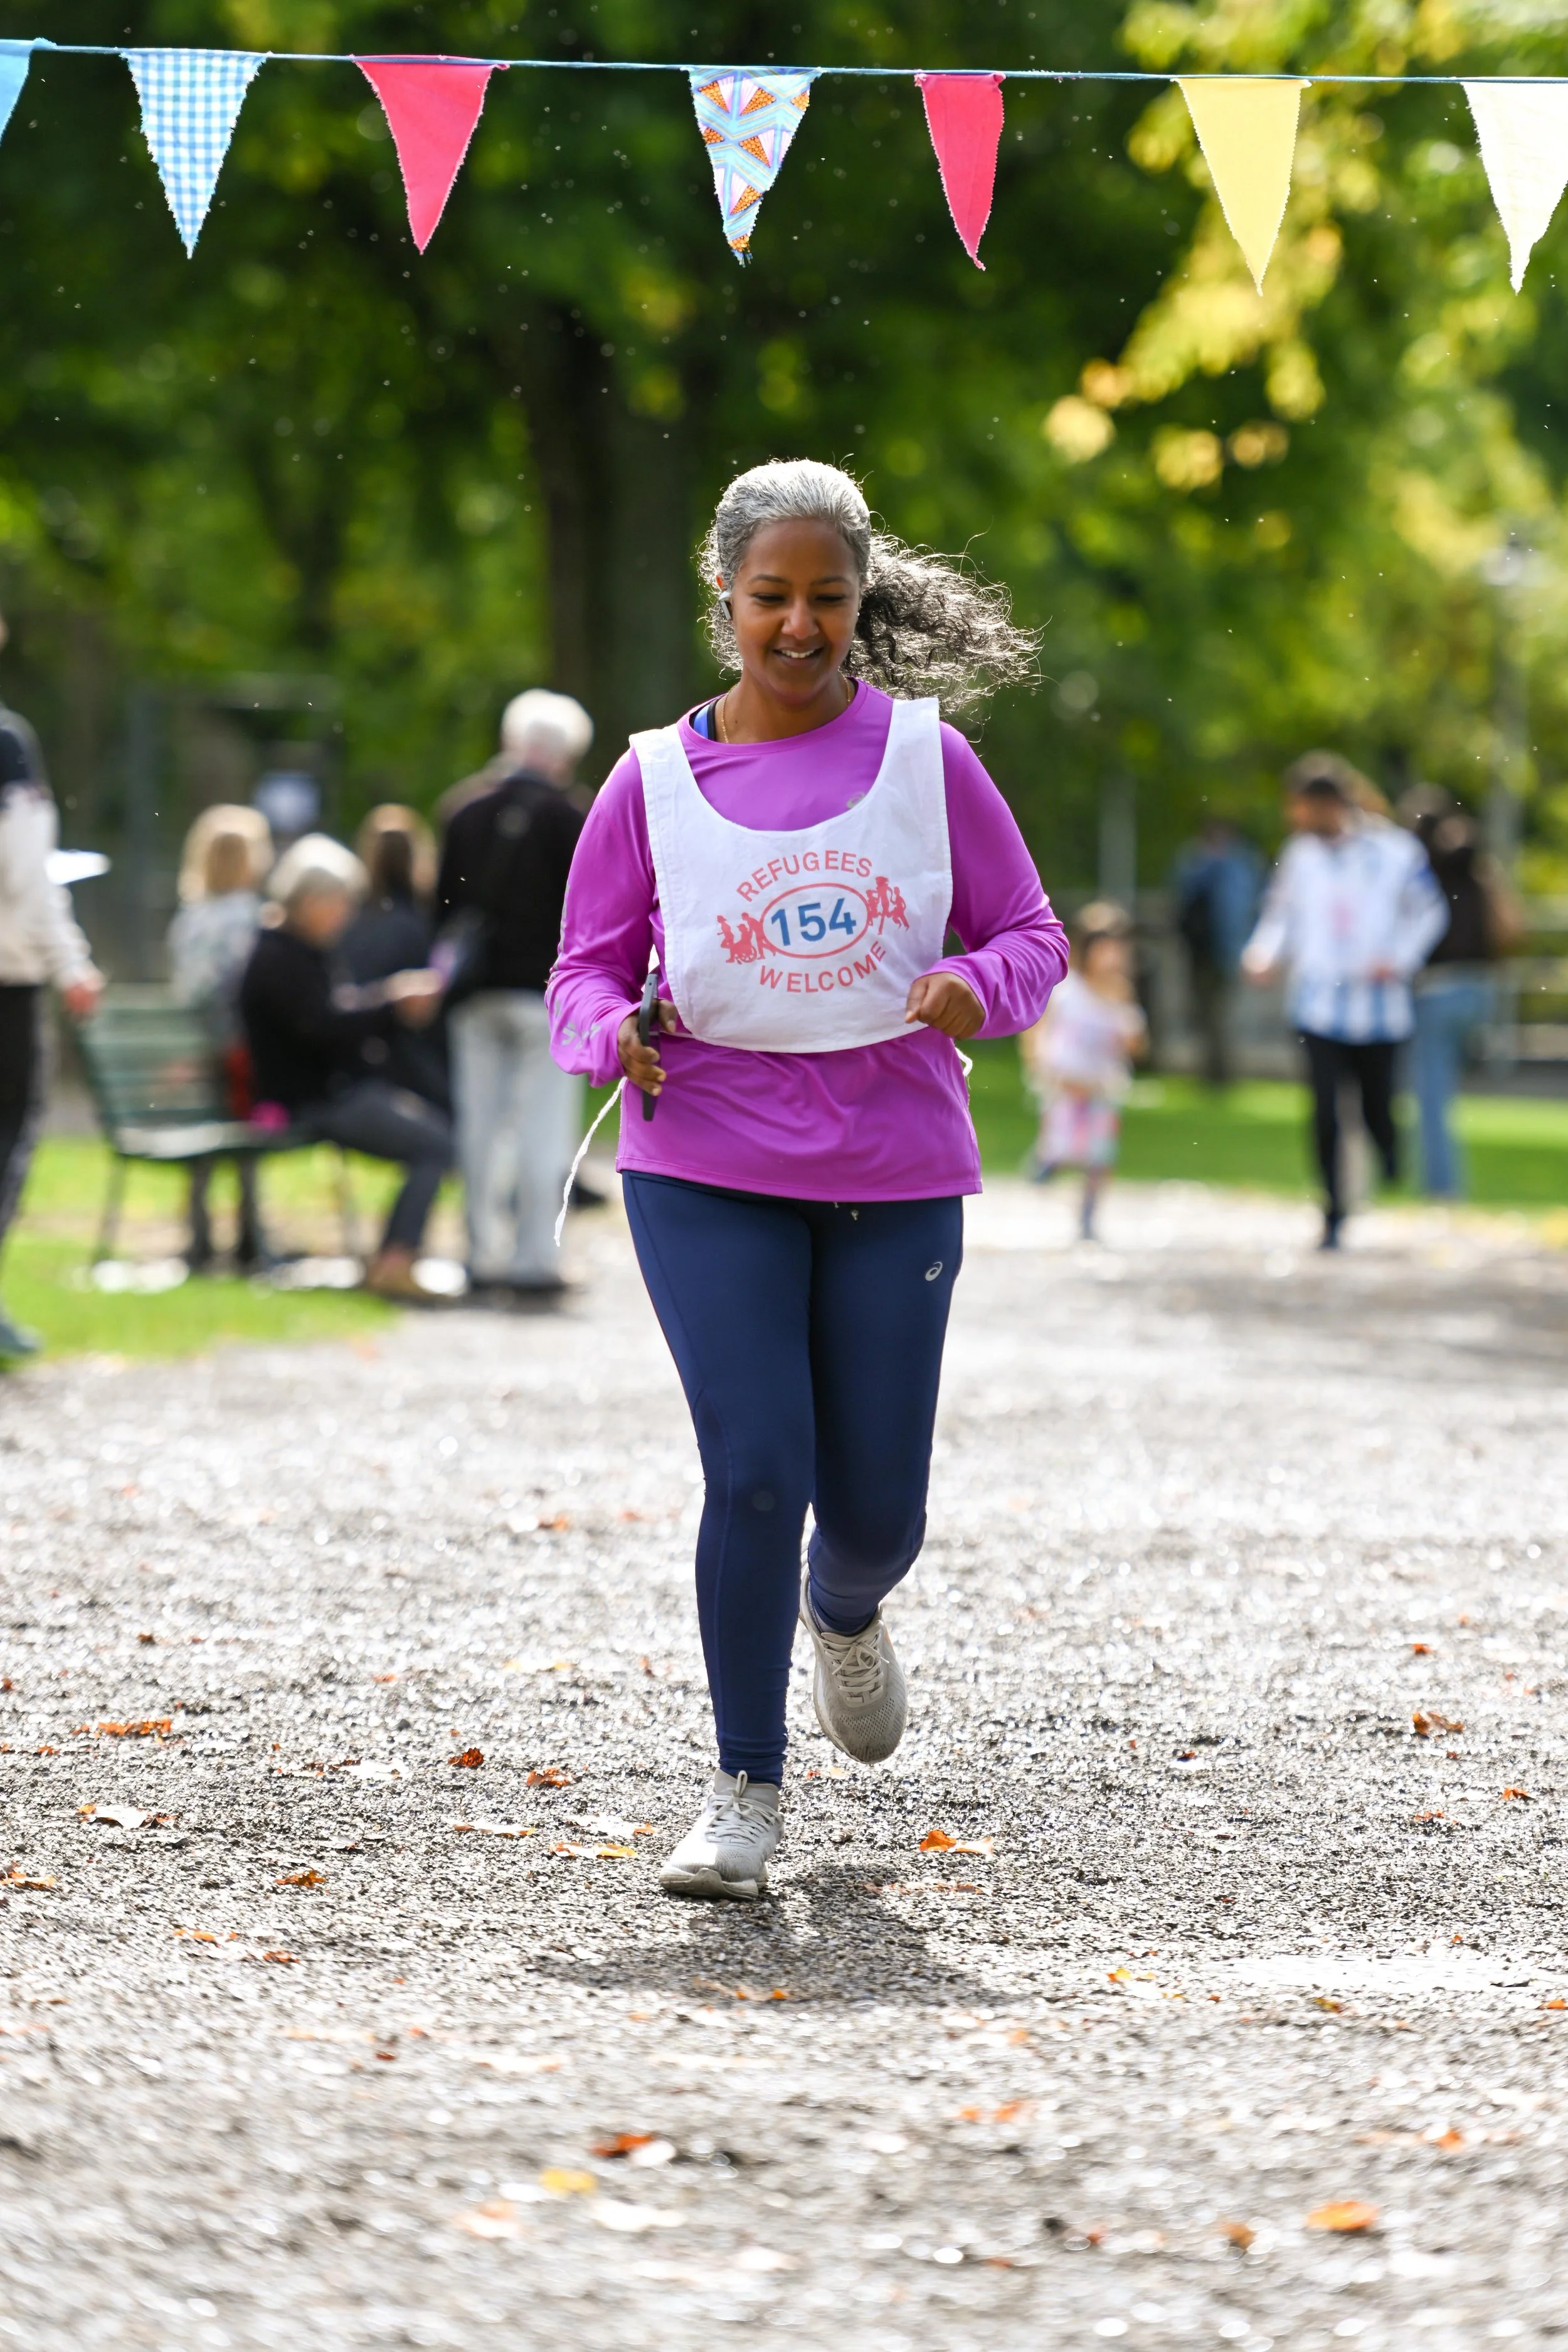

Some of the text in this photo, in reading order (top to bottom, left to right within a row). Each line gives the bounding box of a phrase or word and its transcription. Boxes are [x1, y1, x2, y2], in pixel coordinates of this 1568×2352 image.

[736, 850, 872, 902] REFUGEES
[771, 898, 857, 946] 154
[760, 941, 886, 993] WELCOME
